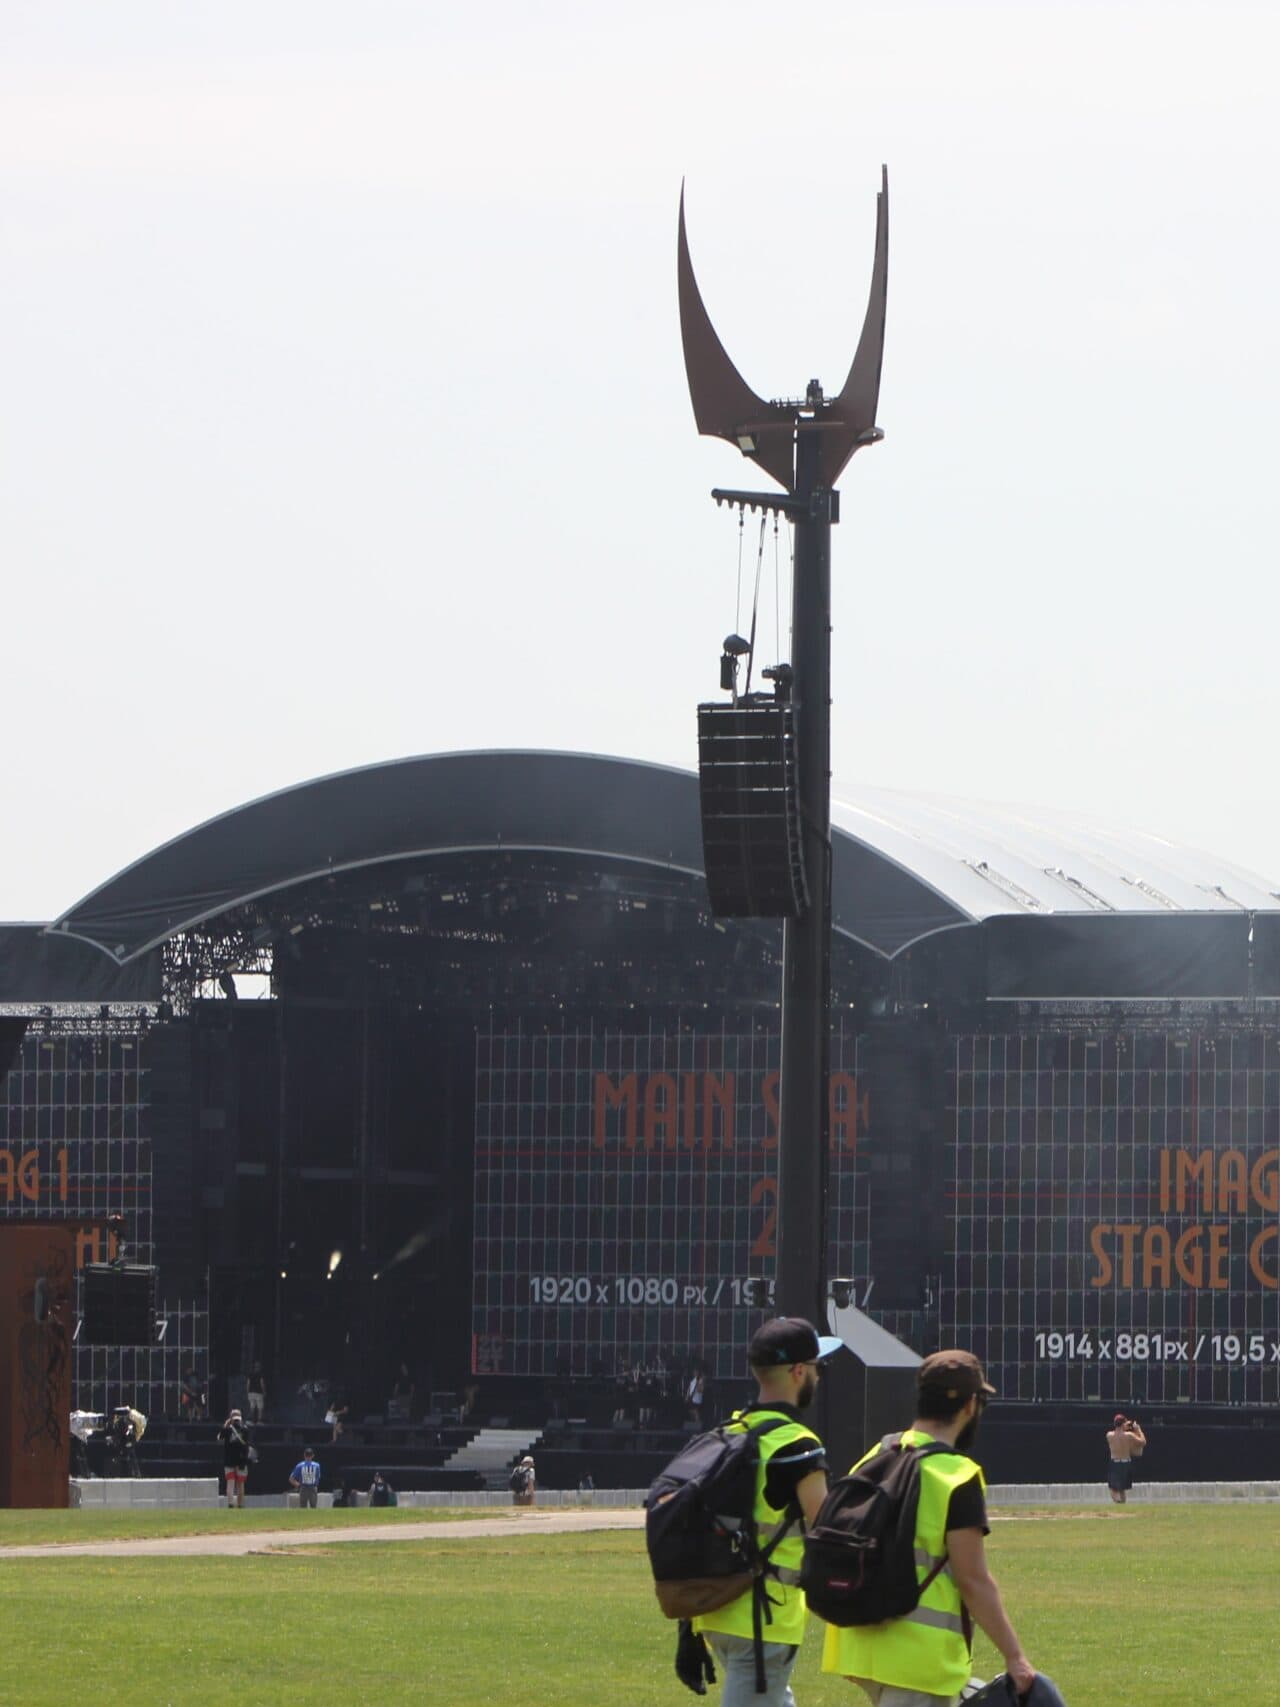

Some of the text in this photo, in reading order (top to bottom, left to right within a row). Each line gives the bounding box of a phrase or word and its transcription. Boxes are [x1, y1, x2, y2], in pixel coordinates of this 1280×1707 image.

[594, 1071, 735, 1148] MAIN
[0, 1149, 68, 1201] AG 1
[1160, 1148, 1279, 1213] IMAG
[751, 1176, 778, 1256] 2
[1090, 1224, 1229, 1288] STAGE
[530, 1277, 592, 1304] 1920
[615, 1278, 678, 1305] 1080
[683, 1286, 707, 1305] PX
[712, 1279, 724, 1305] /
[1035, 1333, 1093, 1359] 1914
[1192, 1334, 1205, 1361] /
[1211, 1335, 1265, 1366] 19,5
